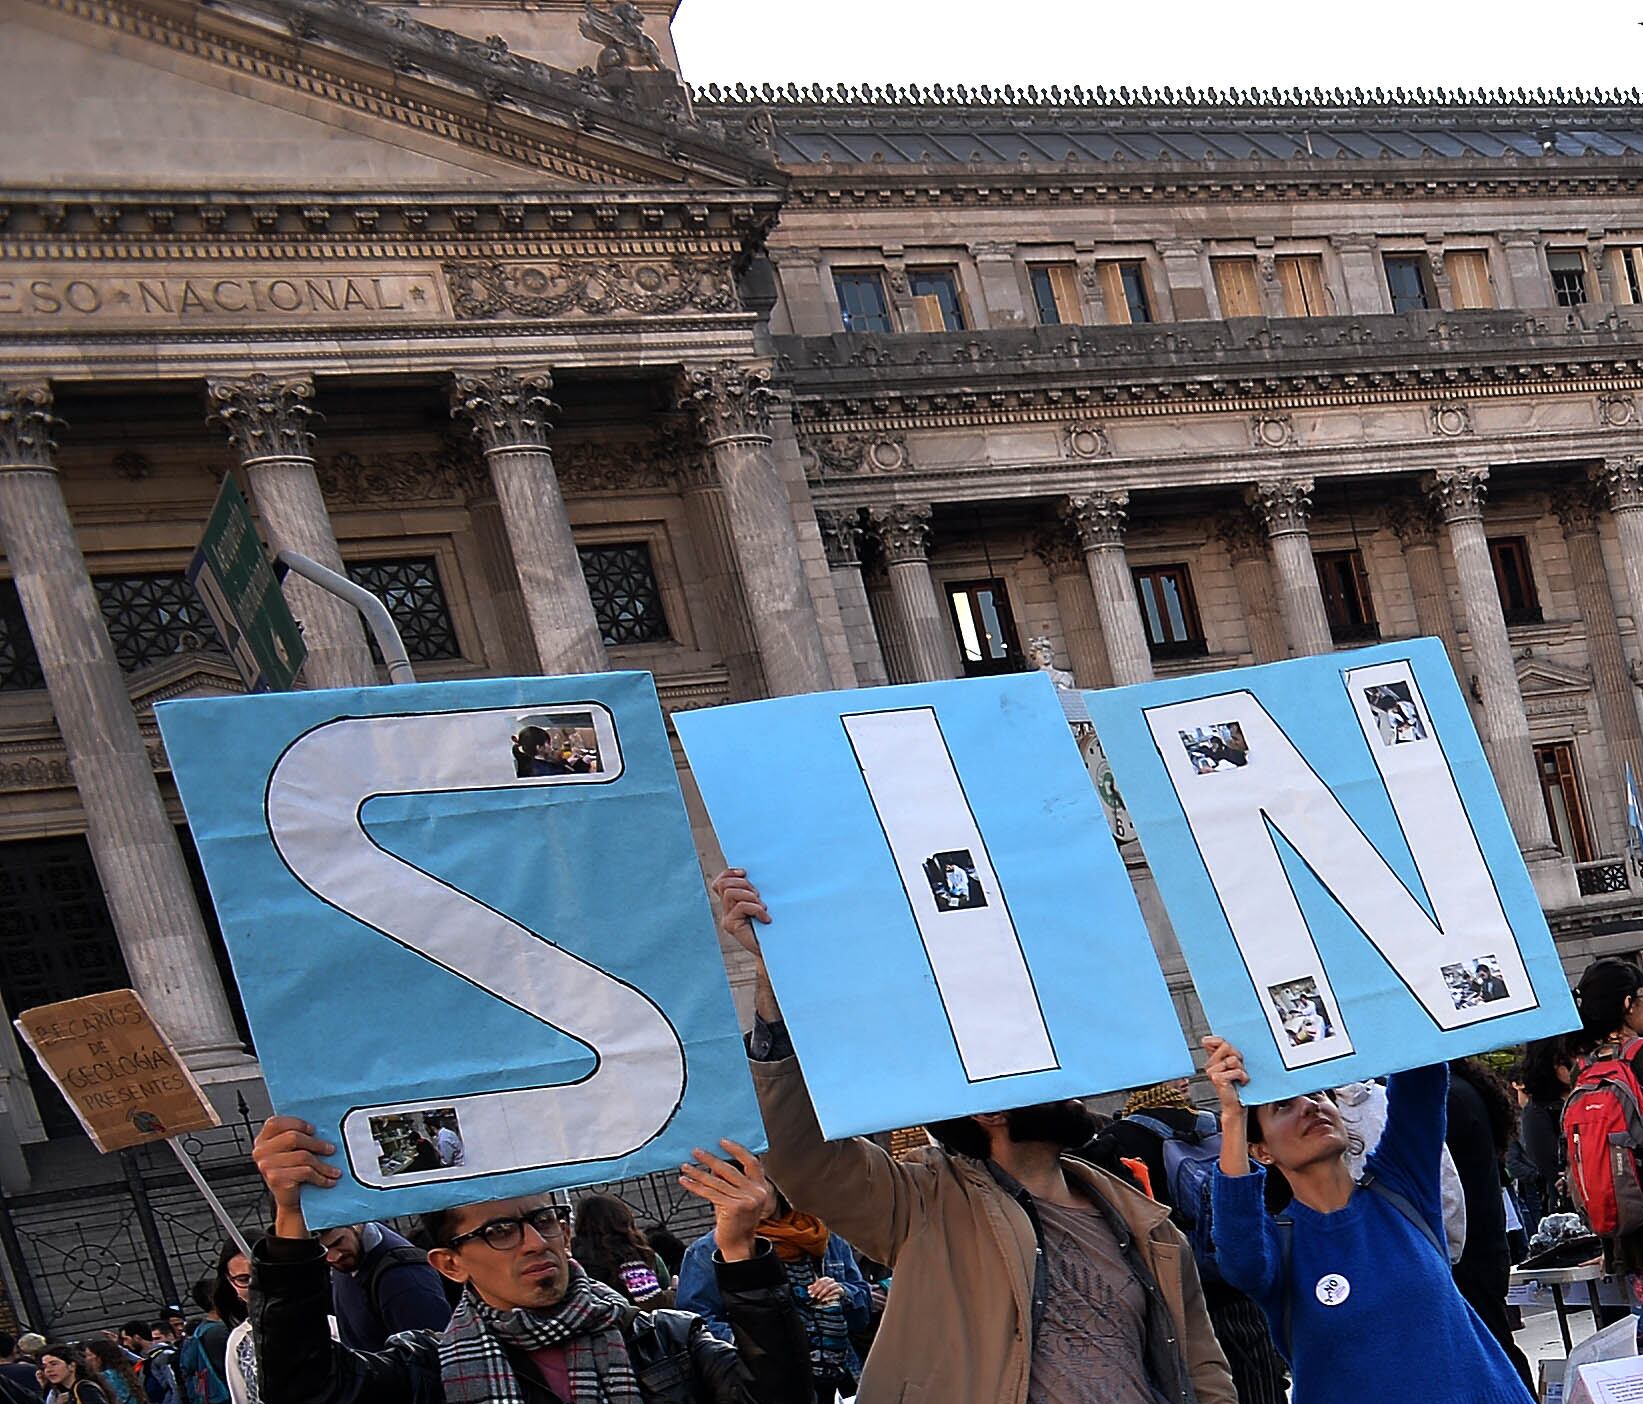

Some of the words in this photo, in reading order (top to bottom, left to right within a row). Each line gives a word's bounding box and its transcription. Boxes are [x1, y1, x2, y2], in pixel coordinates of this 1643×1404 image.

[136, 279, 405, 314] NACIONAL
[36, 1003, 142, 1044] BECARIOS
[88, 1040, 111, 1055] DE
[81, 1073, 184, 1111] PRESENTES
